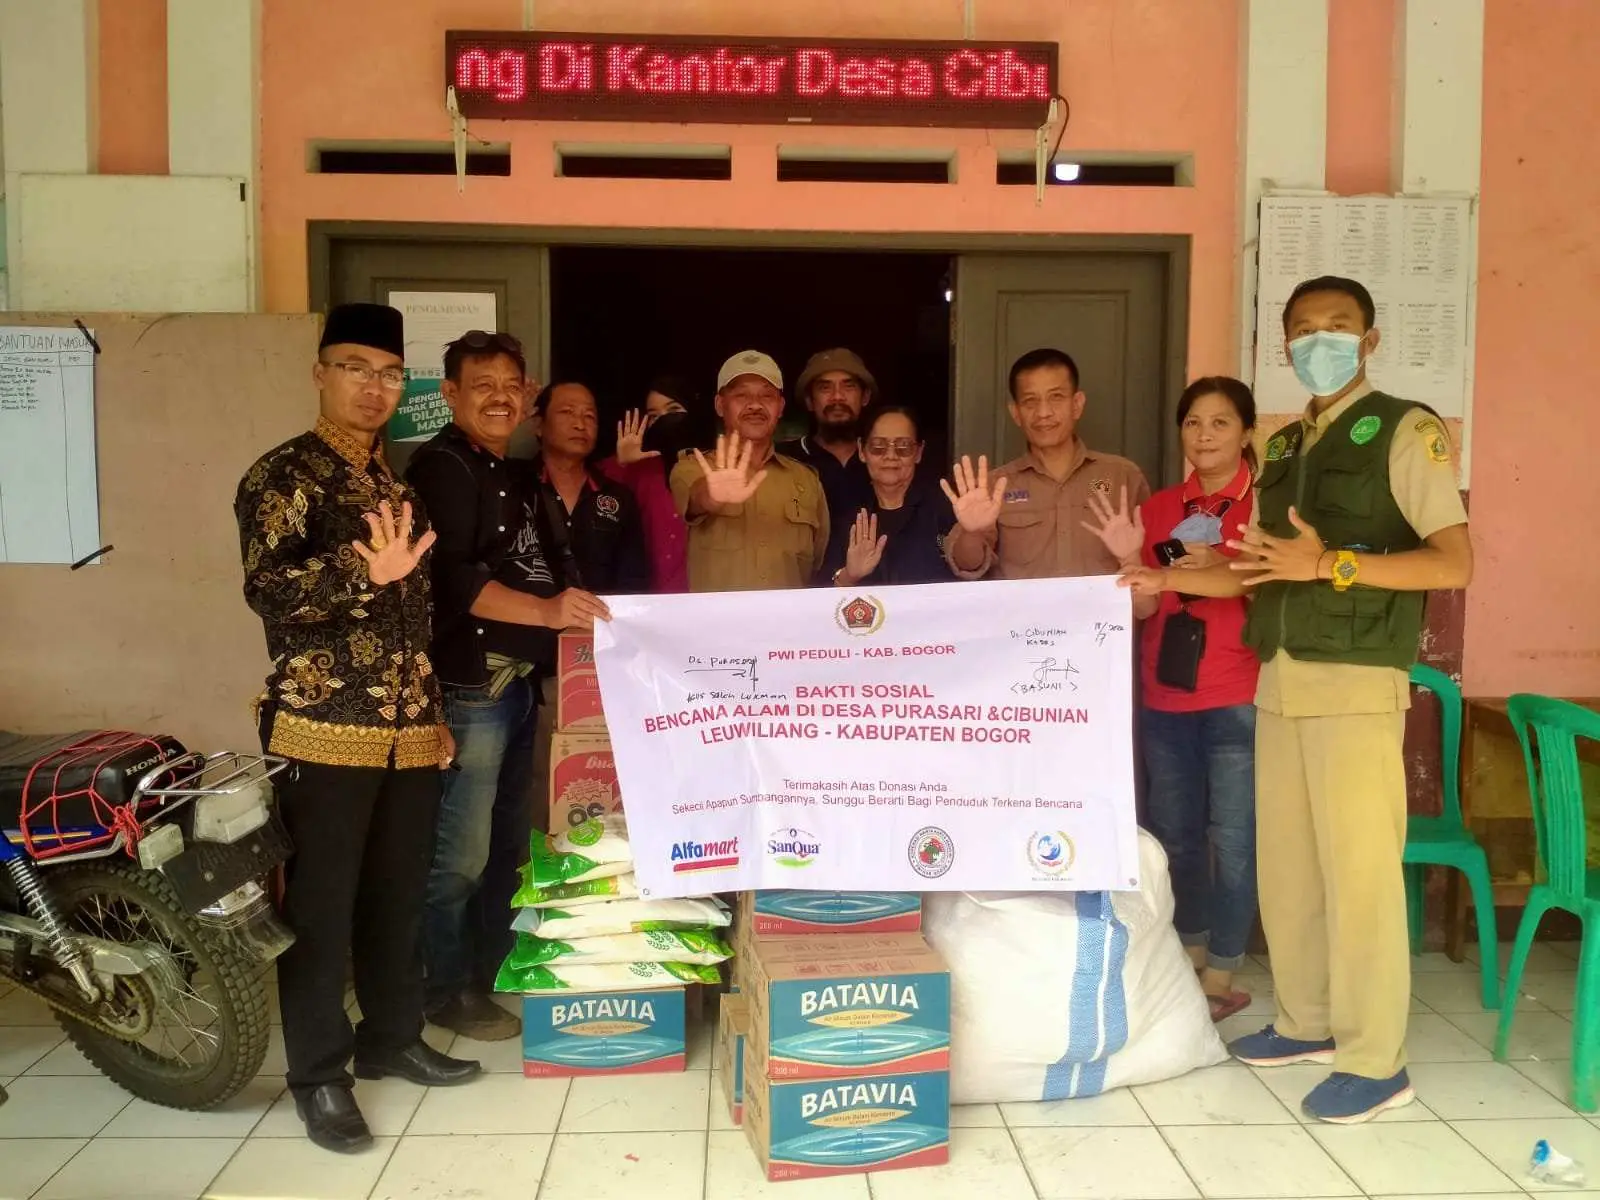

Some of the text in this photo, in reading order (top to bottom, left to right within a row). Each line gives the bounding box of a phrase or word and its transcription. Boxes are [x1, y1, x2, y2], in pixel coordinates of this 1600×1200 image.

[456, 48, 526, 100] ng
[540, 43, 593, 90] Di
[607, 45, 786, 94] Kantor
[799, 48, 934, 96] Desa
[397, 400, 448, 415] TIDAK BER
[408, 392, 444, 405] PENGU
[411, 408, 453, 422] DILAR
[769, 650, 795, 660] PWI
[799, 649, 850, 660] PEDULI
[863, 647, 897, 657] KAB.
[902, 645, 956, 656] BOGOR
[796, 684, 934, 699] BAKTI SOSIAL
[645, 704, 728, 733] BENCANA
[732, 704, 789, 717] ALAM
[796, 704, 815, 717] DI
[822, 704, 876, 718] DESA
[882, 704, 981, 721] PURASARI
[701, 722, 818, 745] LEUWILIANG
[837, 724, 955, 743] KABUPATEN
[961, 727, 1031, 744] BOGOR
[783, 778, 948, 792] Terimakasih Atas Donasi Anda
[672, 801, 704, 814] Sekecil
[706, 798, 738, 810] Apapun
[822, 795, 865, 807] Sunggu
[868, 795, 904, 806] Berarti
[907, 796, 932, 808] Bagi
[935, 796, 989, 807] Penduduk
[991, 797, 1032, 808] Terkena
[1035, 798, 1083, 809] Bencana
[671, 836, 739, 861] Alfamart
[767, 840, 820, 858] SanQua
[801, 982, 919, 1016] BATAVIA
[552, 998, 656, 1026] BATAVIA
[802, 1083, 917, 1118] BATAVIA
